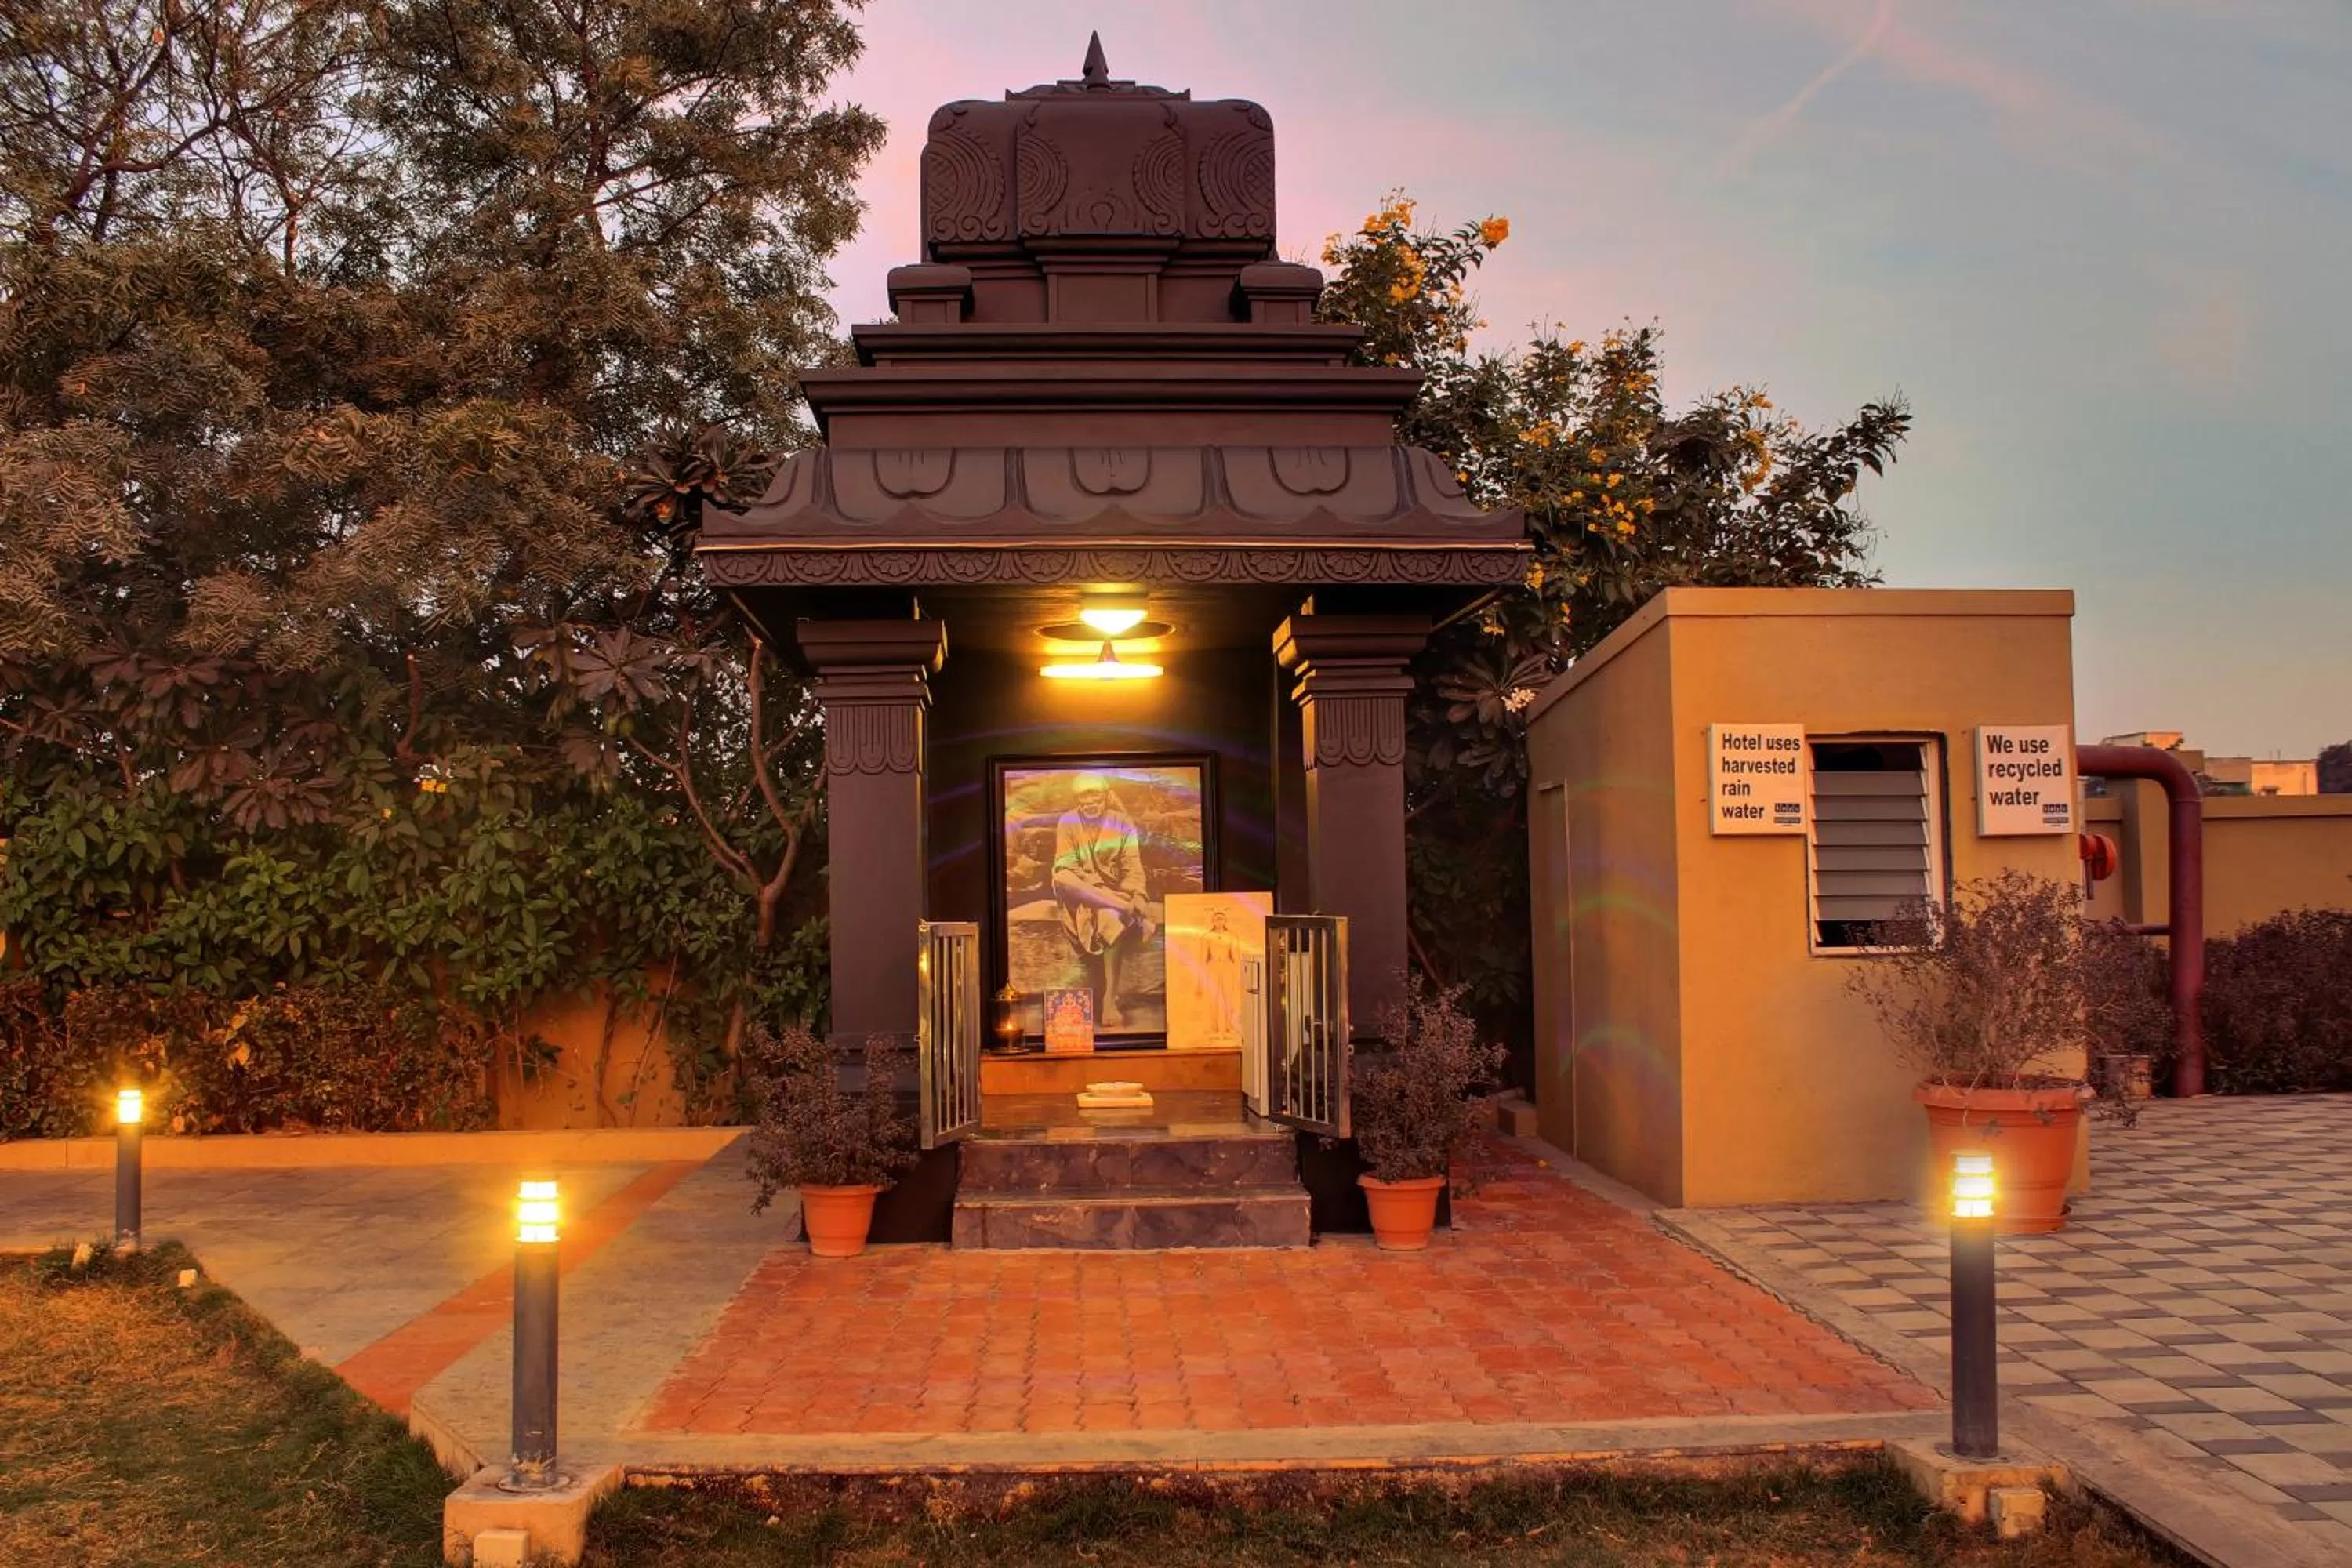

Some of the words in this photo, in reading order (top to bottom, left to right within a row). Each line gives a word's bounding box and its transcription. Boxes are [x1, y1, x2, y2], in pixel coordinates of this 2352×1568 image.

[1722, 733, 1762, 750] Hotel
[1766, 737, 1801, 751] uses
[1987, 735, 2013, 753] We
[2019, 739, 2049, 753] use
[1722, 757, 1795, 774] harvested
[1988, 759, 2062, 782] recycled
[1722, 779, 1751, 796] rain
[1989, 787, 2040, 806] water
[1722, 803, 1765, 819] water
